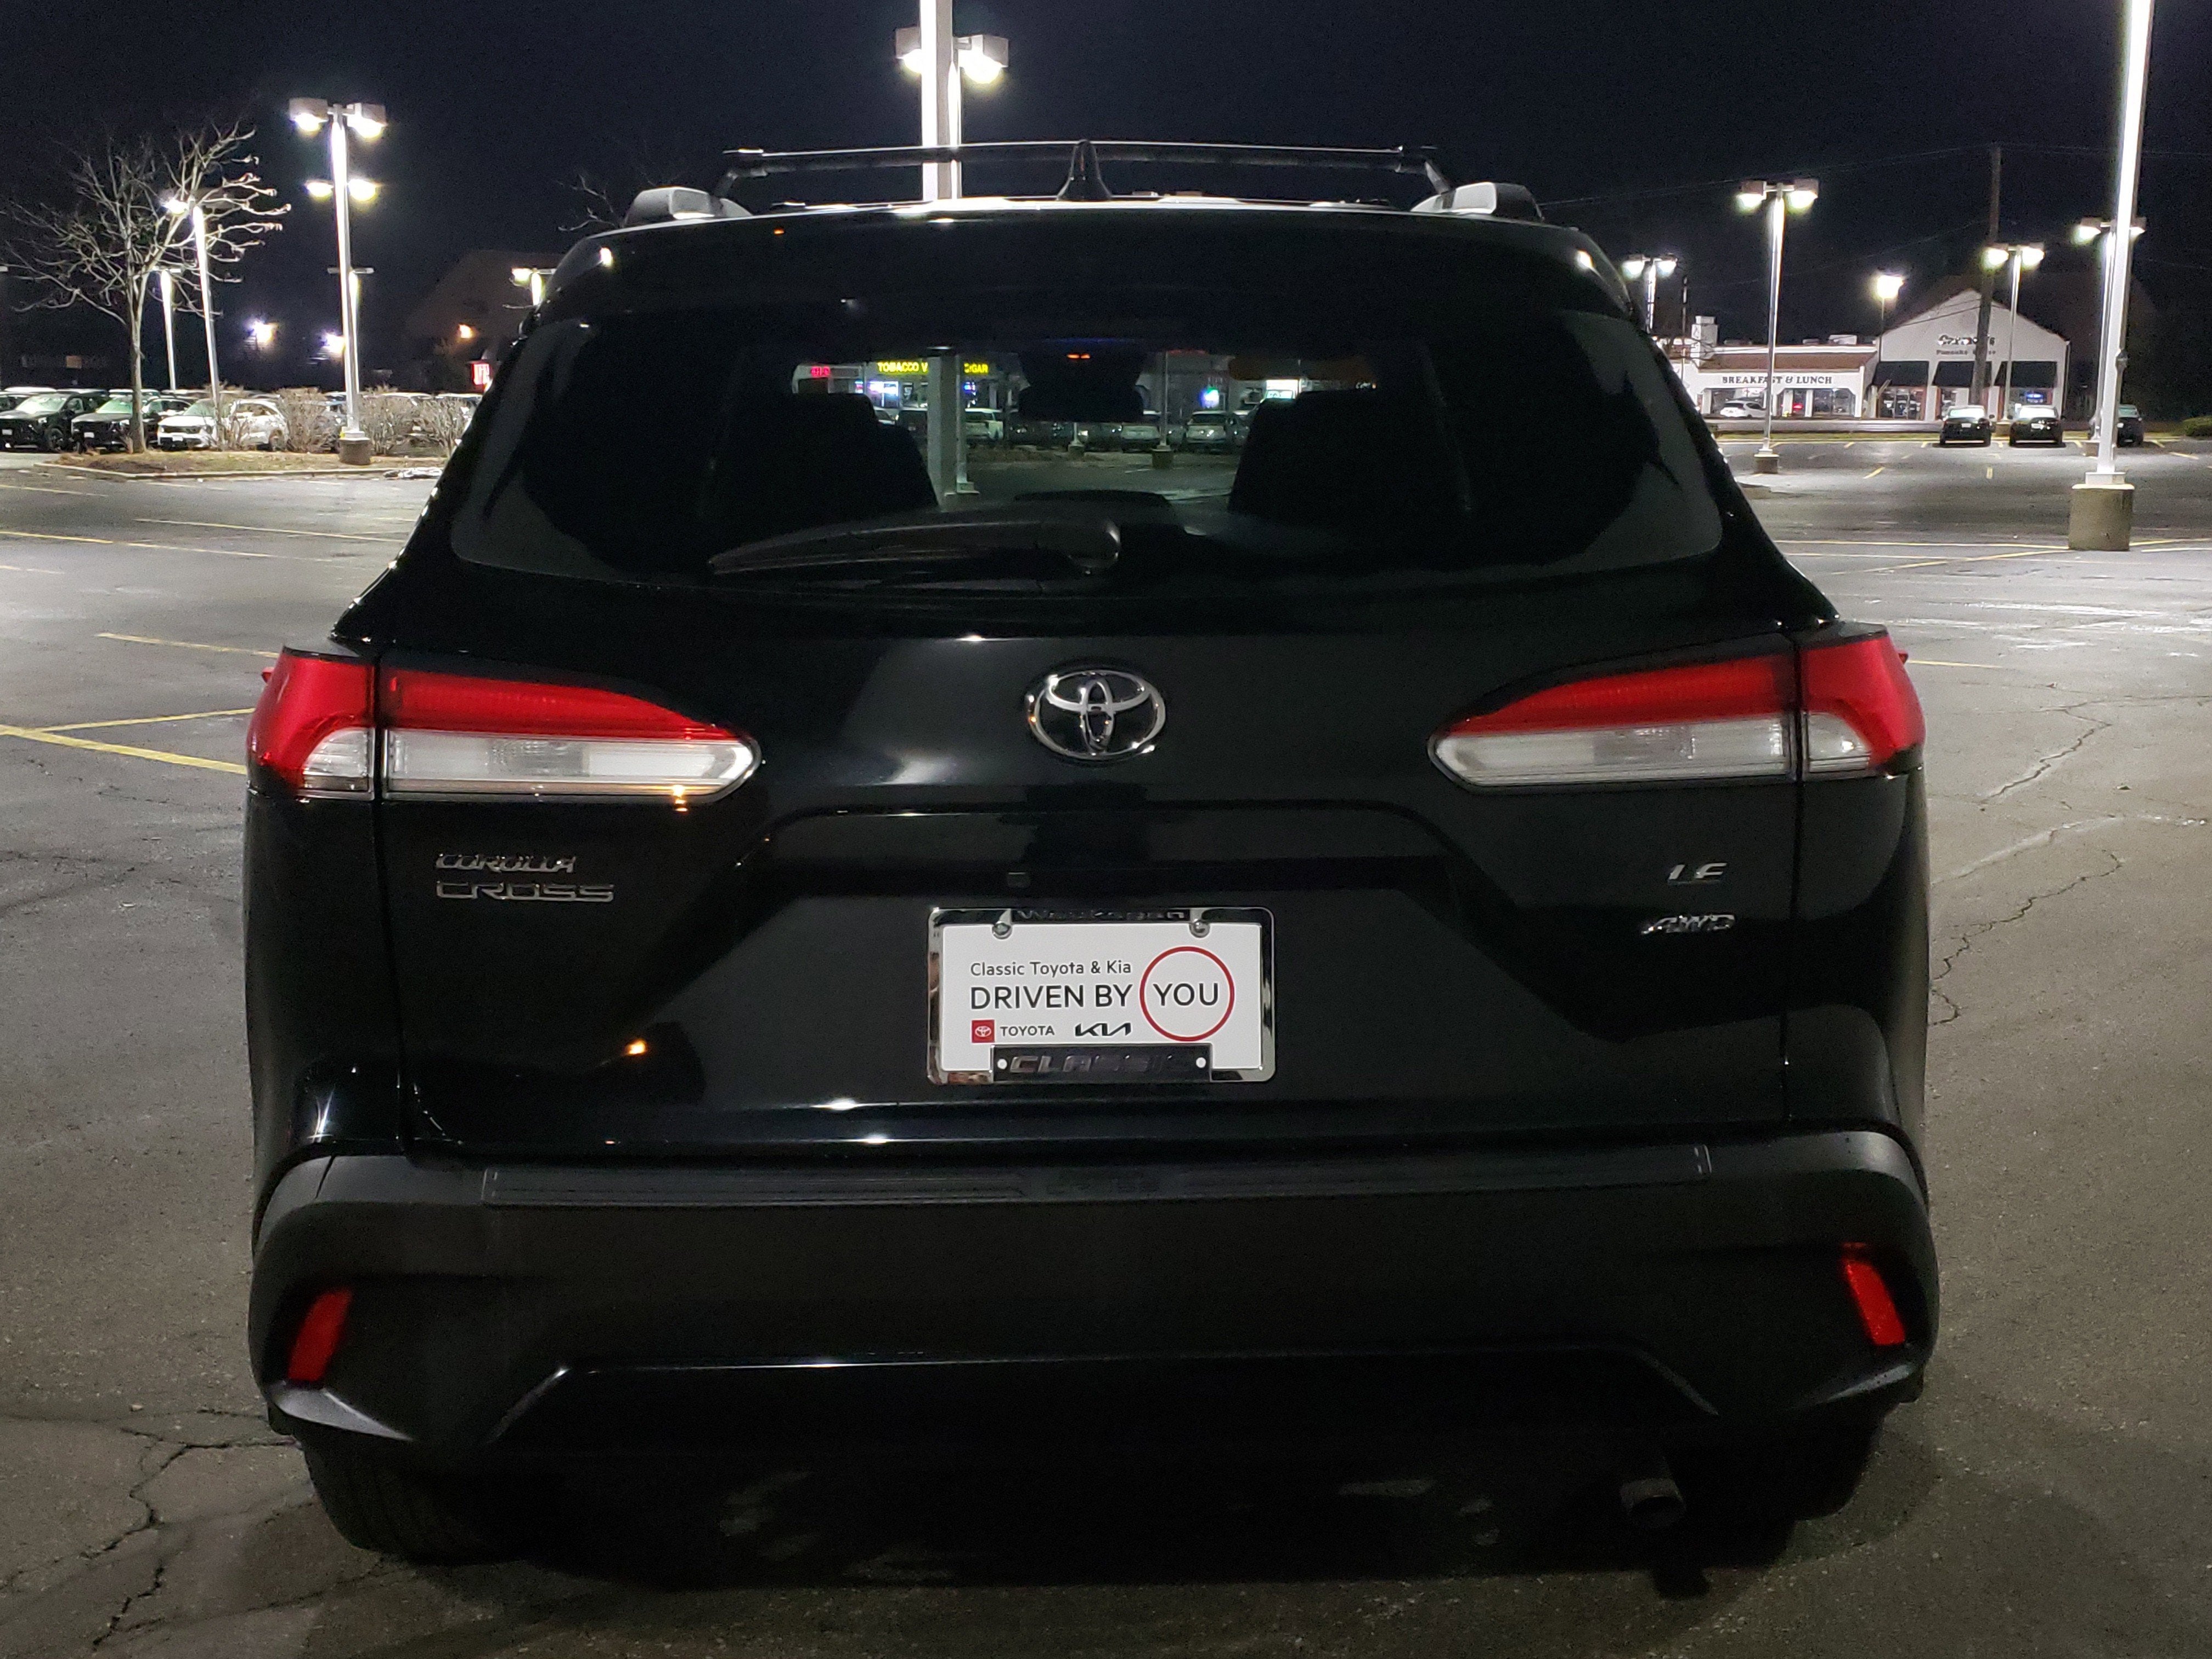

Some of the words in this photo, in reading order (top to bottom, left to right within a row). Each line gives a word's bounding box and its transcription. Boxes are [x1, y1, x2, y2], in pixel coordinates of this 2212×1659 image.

[1796, 376, 1832, 384] LUNCH
[1667, 862, 1728, 885] LE
[436, 880, 614, 902] CROSS
[970, 962, 1025, 976] Classic
[1029, 961, 1084, 978] Toyota
[1091, 961, 1101, 974] &
[1107, 960, 1132, 974] Kia
[971, 984, 1084, 1009] DRIVEN
[1095, 984, 1133, 1008] BY
[1153, 982, 1220, 1007] YOU
[1000, 1025, 1055, 1037] TOYOTA
